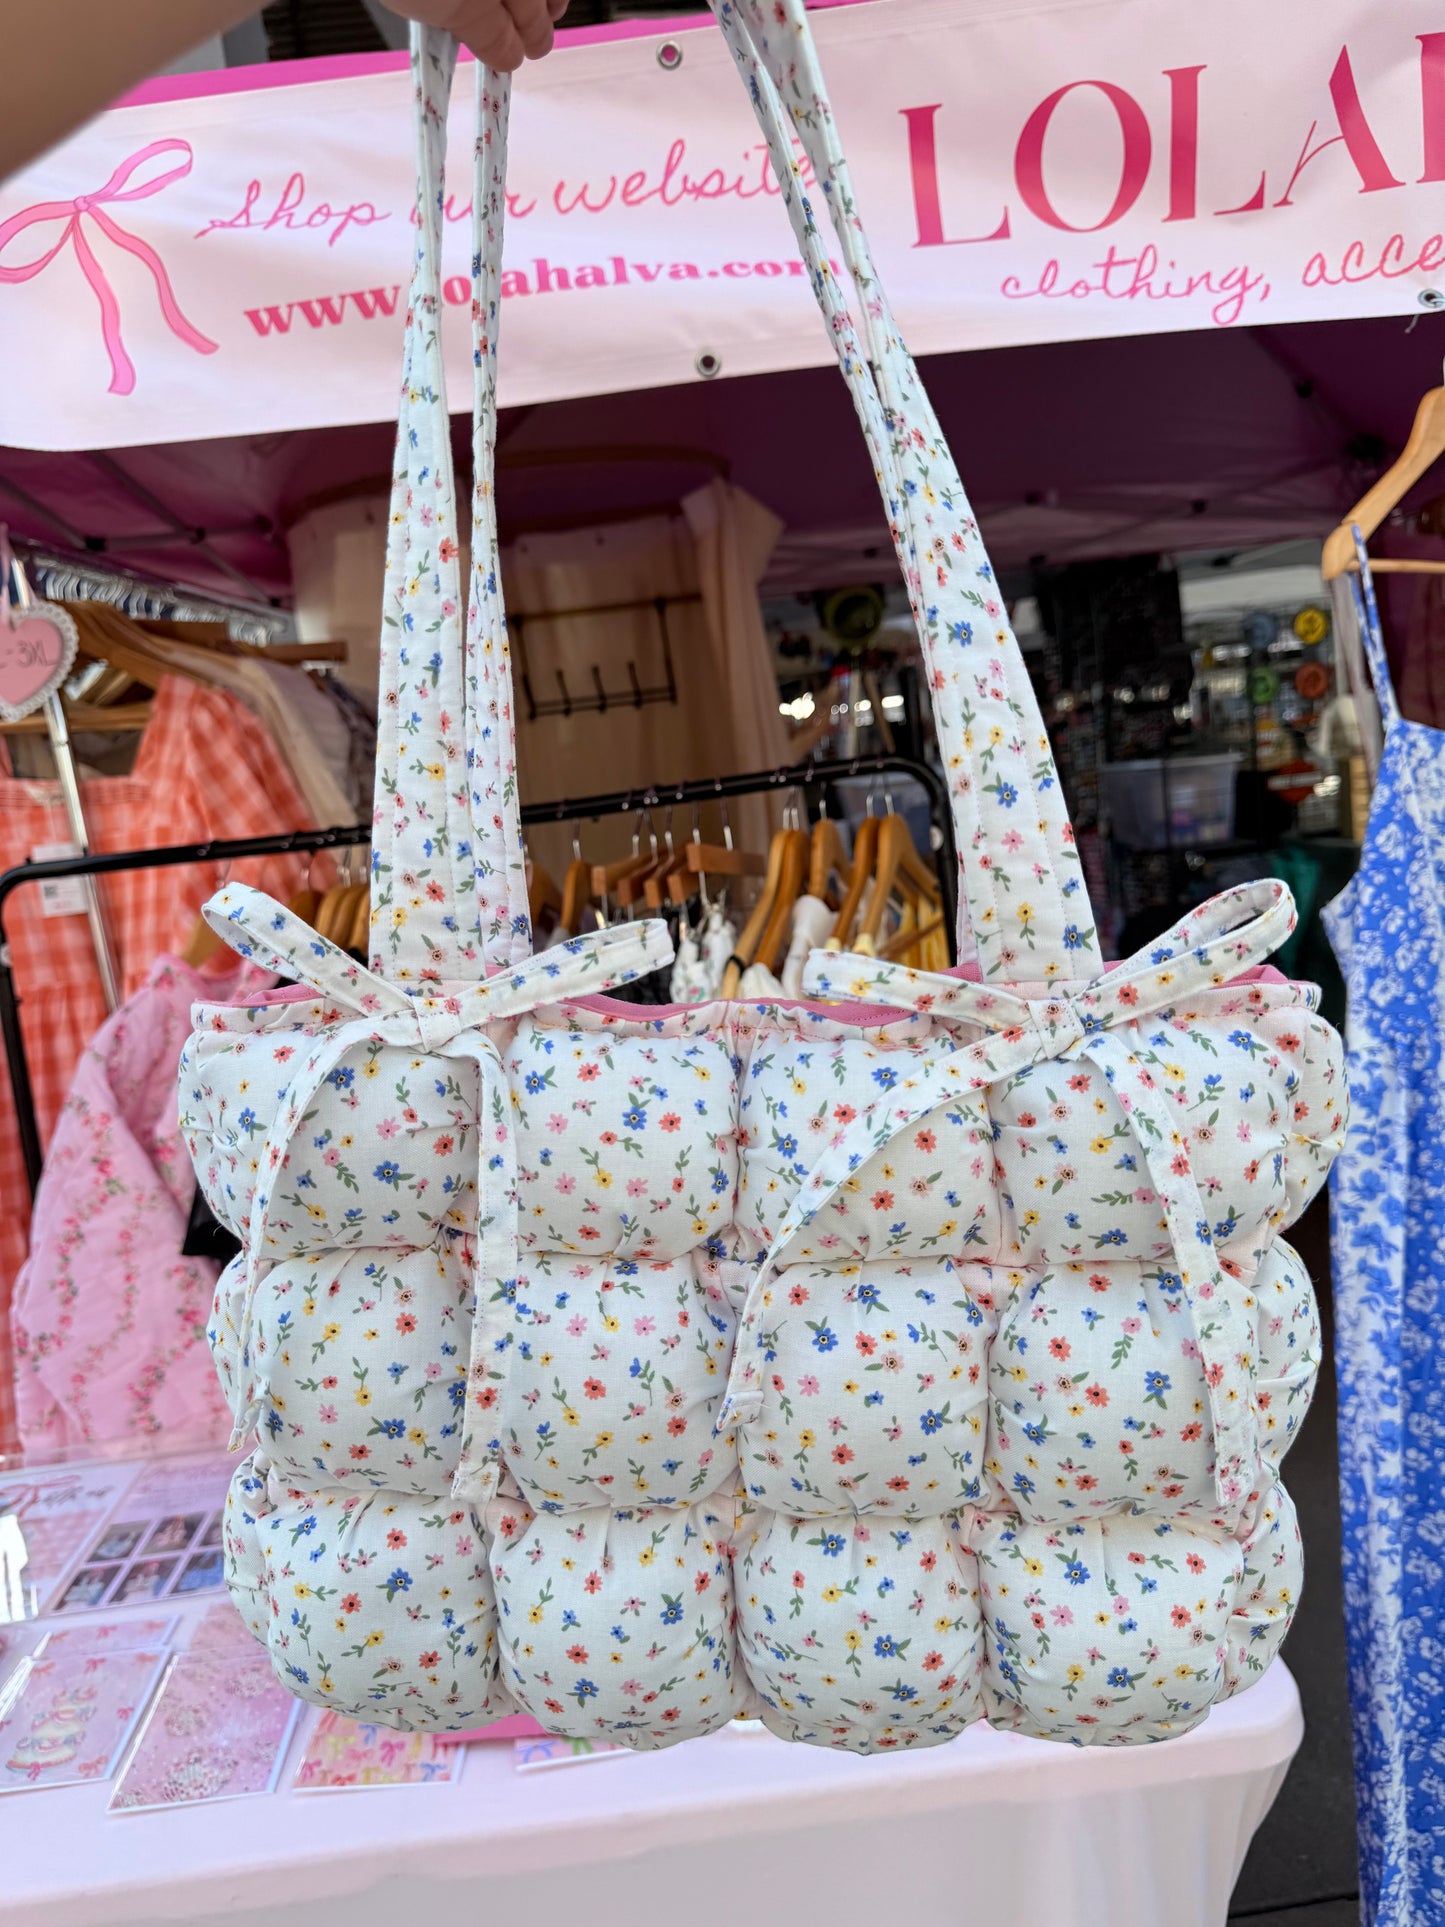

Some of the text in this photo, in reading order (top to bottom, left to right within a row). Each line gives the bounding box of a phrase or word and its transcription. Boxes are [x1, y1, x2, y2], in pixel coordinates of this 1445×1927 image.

[898, 32, 1445, 248] LOLA
[409, 186, 538, 224] ur
[1000, 243, 1271, 326] clothing,
